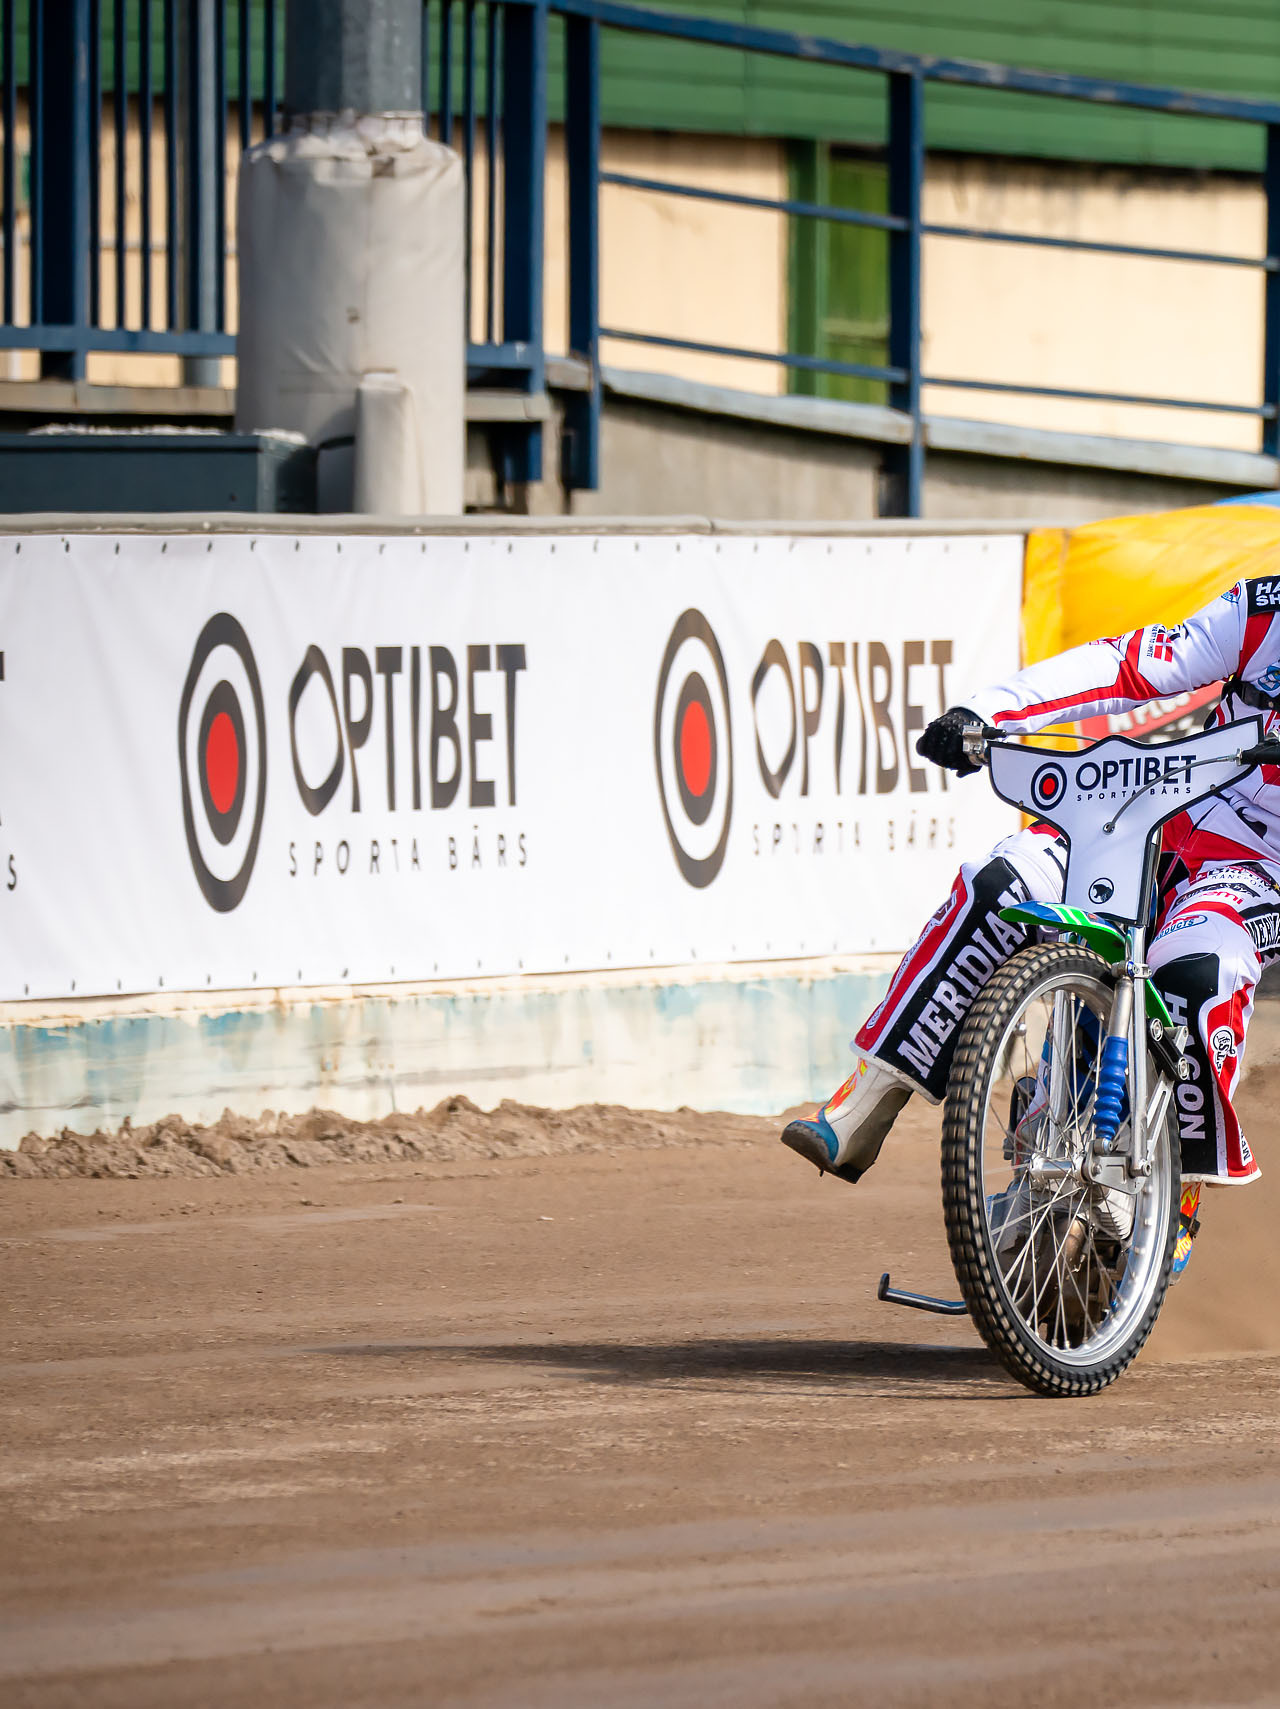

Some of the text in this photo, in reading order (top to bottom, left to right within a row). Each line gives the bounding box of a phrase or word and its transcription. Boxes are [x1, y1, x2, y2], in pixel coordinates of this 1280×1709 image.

[288, 643, 528, 816] OPTIBET
[751, 638, 955, 799] OPTIBET
[1076, 754, 1197, 791] OPTIBET
[1076, 788, 1137, 802] SPORTA
[288, 825, 528, 877] SPORTA BĀRS
